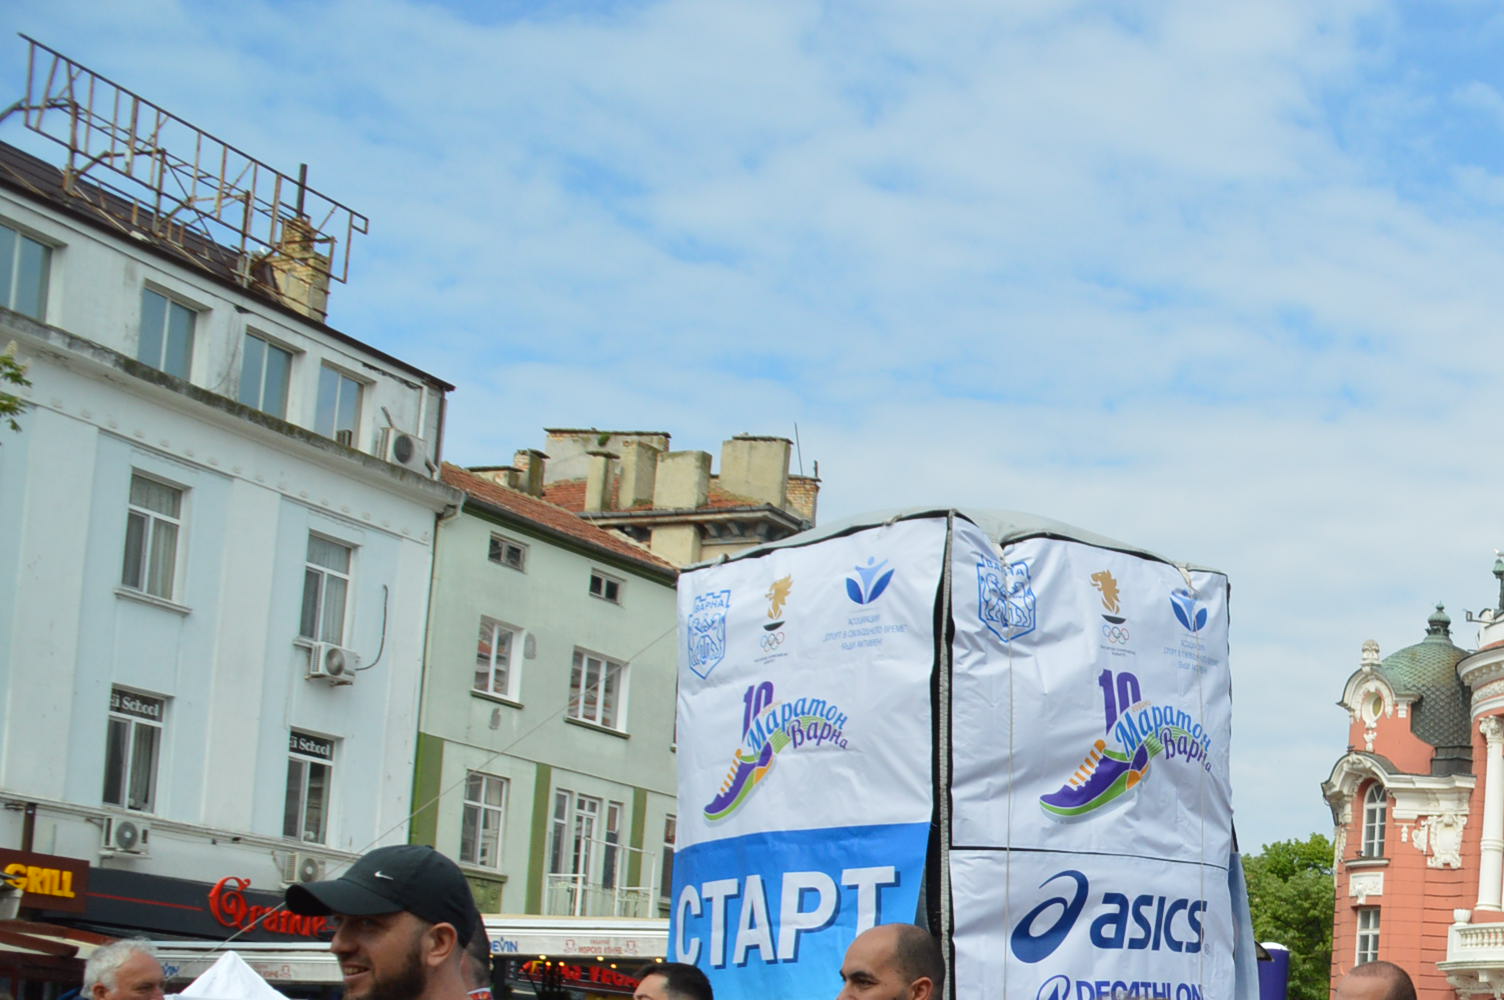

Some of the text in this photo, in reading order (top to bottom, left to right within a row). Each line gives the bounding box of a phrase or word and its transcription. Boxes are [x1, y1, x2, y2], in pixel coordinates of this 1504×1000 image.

[741, 681, 774, 743] 10
[747, 697, 848, 754] Маратон
[1098, 668, 1142, 736] 10
[787, 719, 848, 749] Варна
[1115, 705, 1211, 758] Маратон
[1159, 727, 1212, 773] Варна
[3, 862, 76, 898] GRILL
[675, 865, 898, 968] СТАРТ
[490, 940, 519, 953] EVIN
